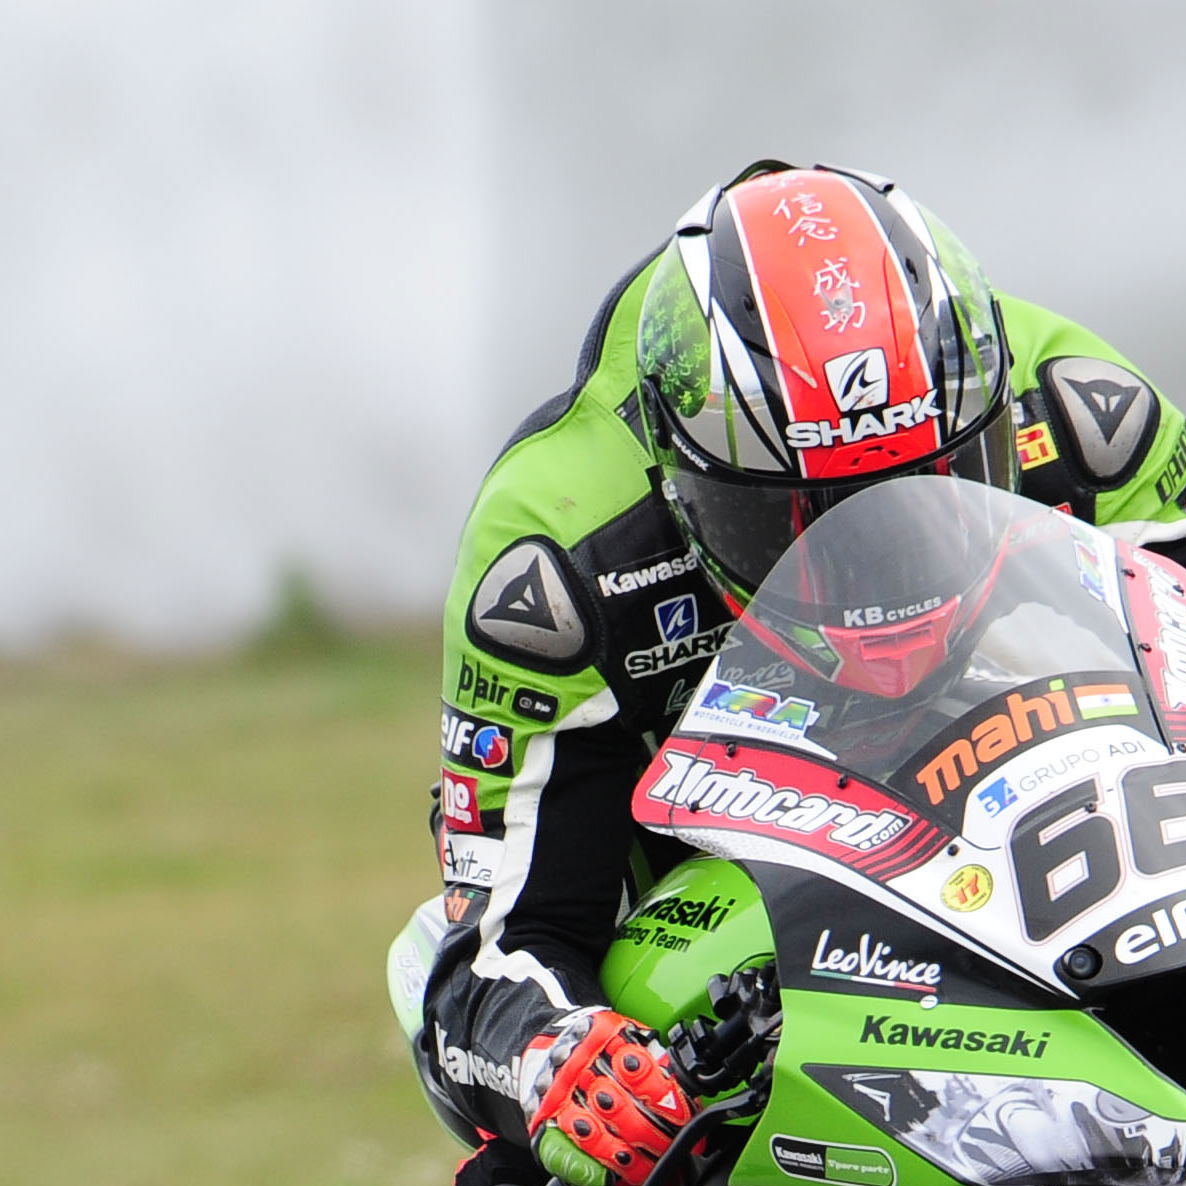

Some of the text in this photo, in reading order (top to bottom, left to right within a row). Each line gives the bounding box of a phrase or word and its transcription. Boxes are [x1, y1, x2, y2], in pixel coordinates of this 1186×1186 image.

[785, 388, 942, 449] SHARK
[671, 433, 712, 472] SHARK
[843, 596, 943, 628] KB CYCLES
[624, 621, 743, 680] SHARK
[915, 678, 1075, 805] mahi
[1019, 740, 1147, 793] GRUPO ADI
[649, 926, 692, 953] Team
[811, 929, 942, 984] LeoVince
[859, 1014, 1051, 1059] Kawasaki
